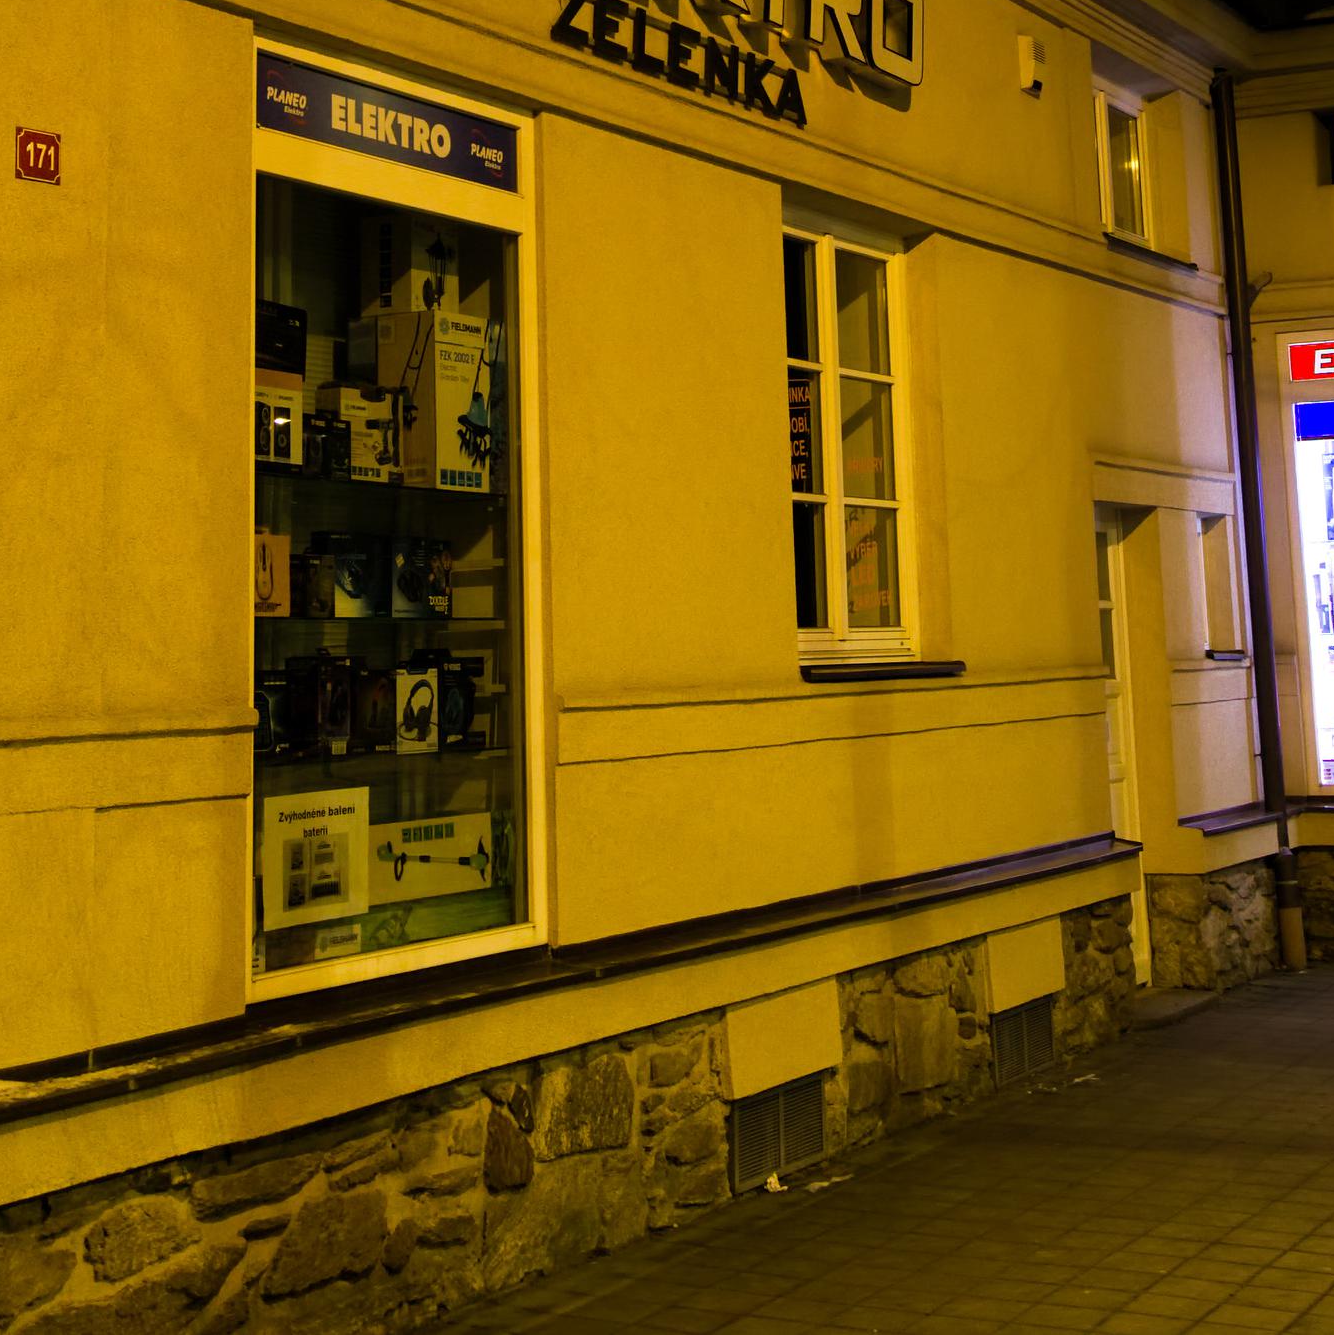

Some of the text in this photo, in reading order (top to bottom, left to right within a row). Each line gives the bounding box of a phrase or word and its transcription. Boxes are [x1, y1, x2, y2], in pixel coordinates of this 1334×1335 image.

[267, 85, 307, 109] PLANEO
[331, 93, 452, 159] ELEKTRO
[26, 141, 55, 171] 171
[470, 143, 503, 164] PLANEO
